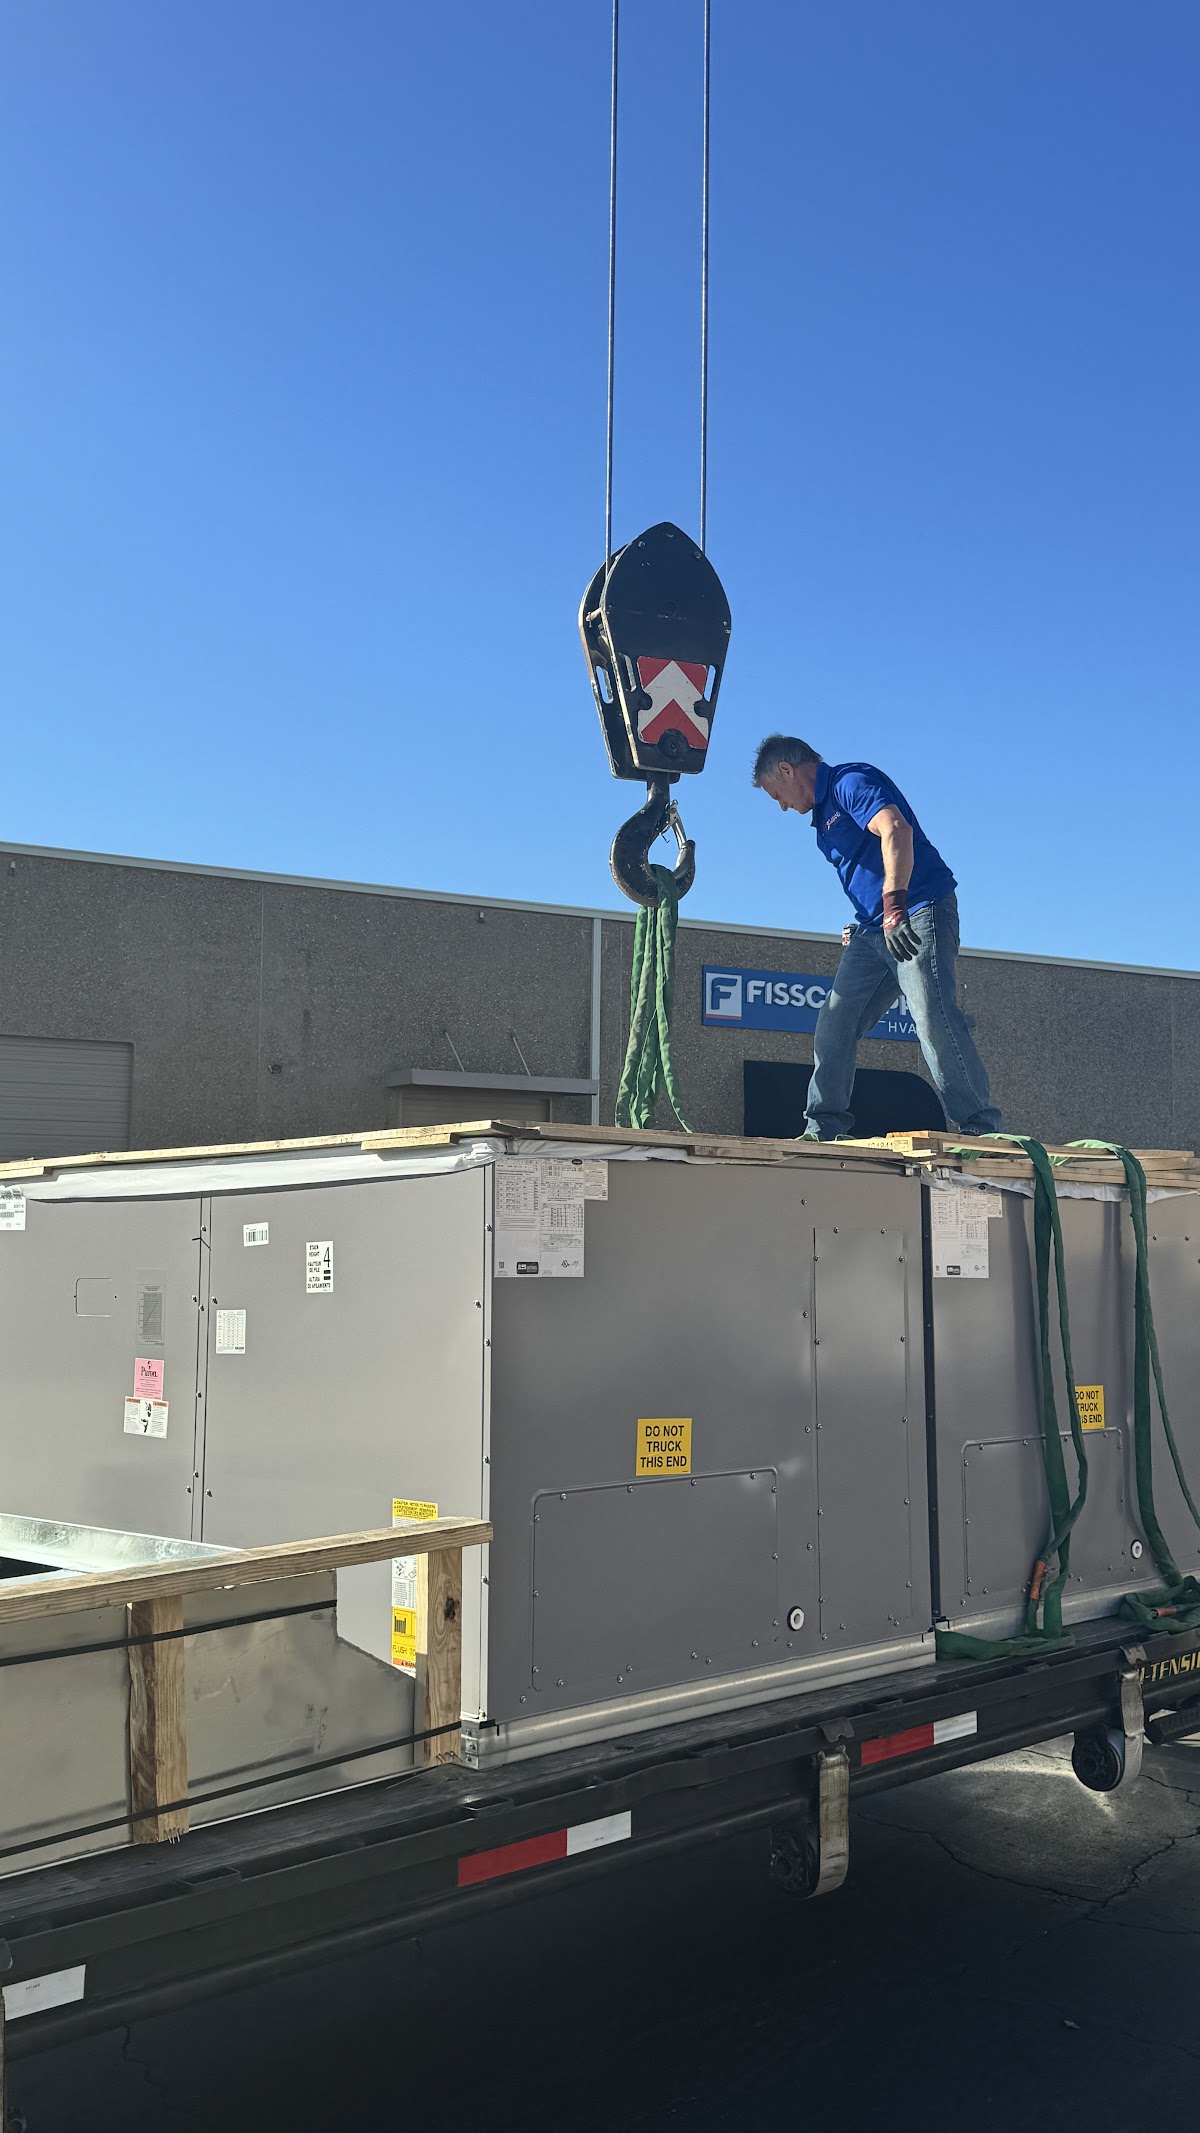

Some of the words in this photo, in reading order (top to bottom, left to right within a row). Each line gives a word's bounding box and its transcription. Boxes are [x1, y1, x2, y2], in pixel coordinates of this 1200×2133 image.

[746, 980, 831, 1008] FISSC
[888, 1021, 917, 1034] HVA
[323, 1246, 331, 1267] 4
[1086, 1390, 1099, 1399] NOT
[1089, 1414, 1102, 1423] END
[645, 1426, 660, 1437] DO
[663, 1425, 684, 1437] NOT
[646, 1440, 682, 1452] TRUCK
[640, 1456, 663, 1468] THIS
[666, 1456, 687, 1467] END
[1137, 1651, 1200, 1685] I-TENSI
